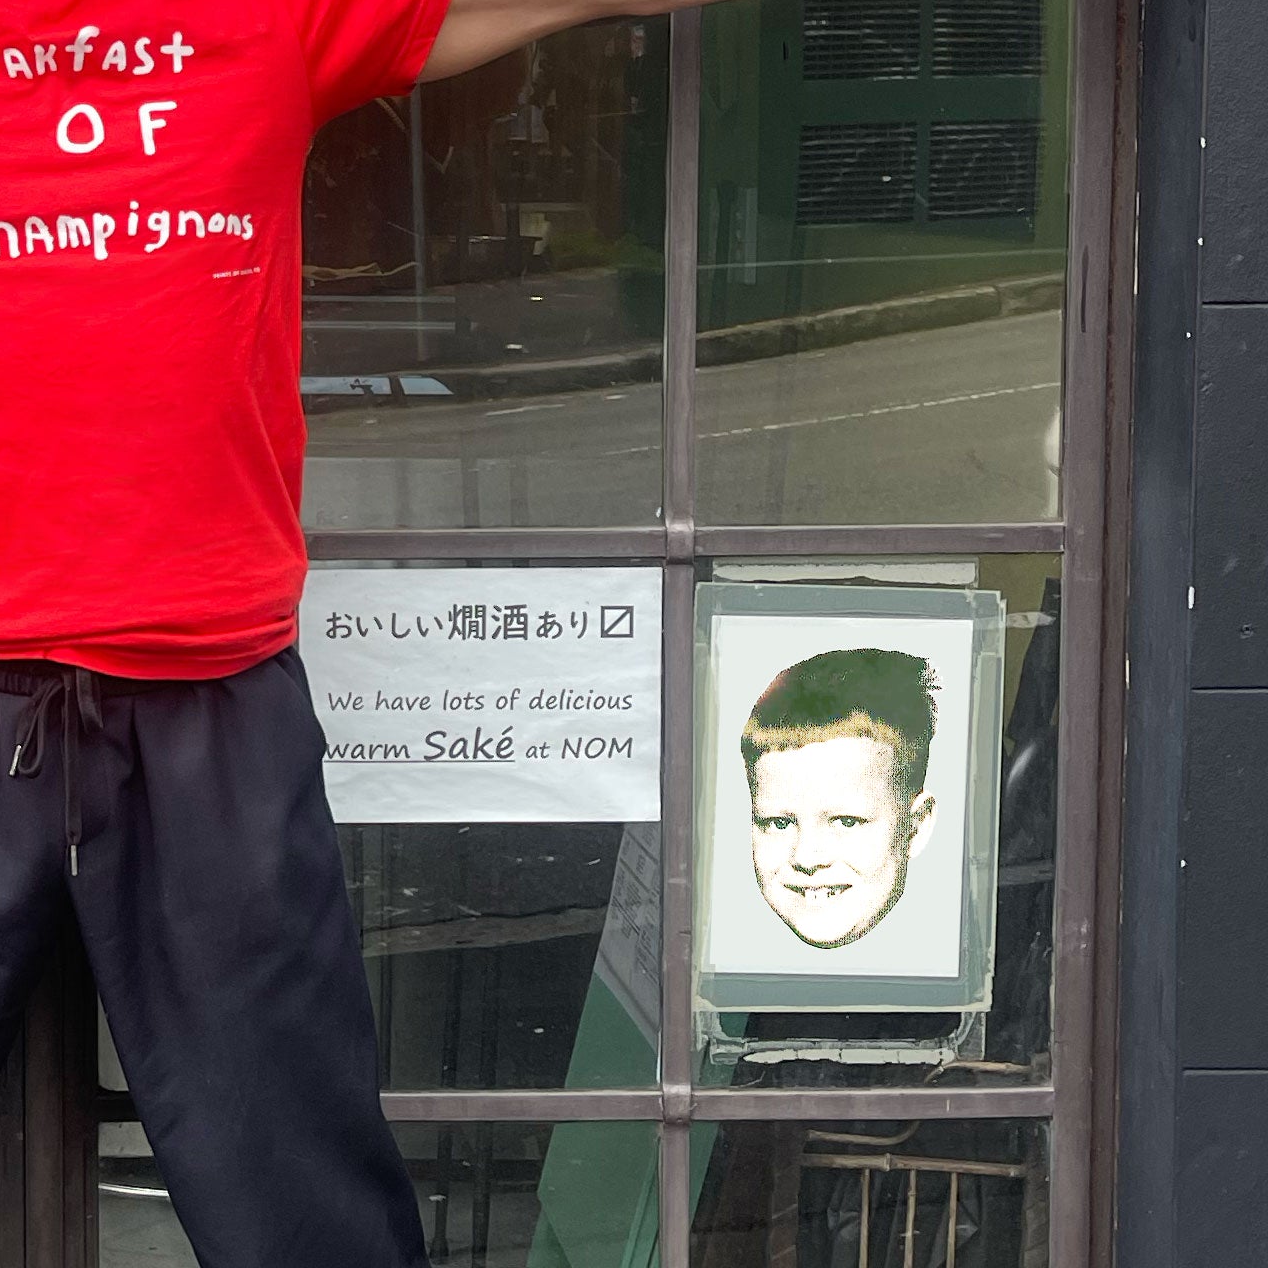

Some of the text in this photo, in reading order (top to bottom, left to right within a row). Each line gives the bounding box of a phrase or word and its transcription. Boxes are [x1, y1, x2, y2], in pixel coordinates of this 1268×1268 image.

[57, 101, 177, 155] OF
[328, 688, 632, 711] We have lots of delicious
[327, 726, 632, 761] warm Saké at NOM
